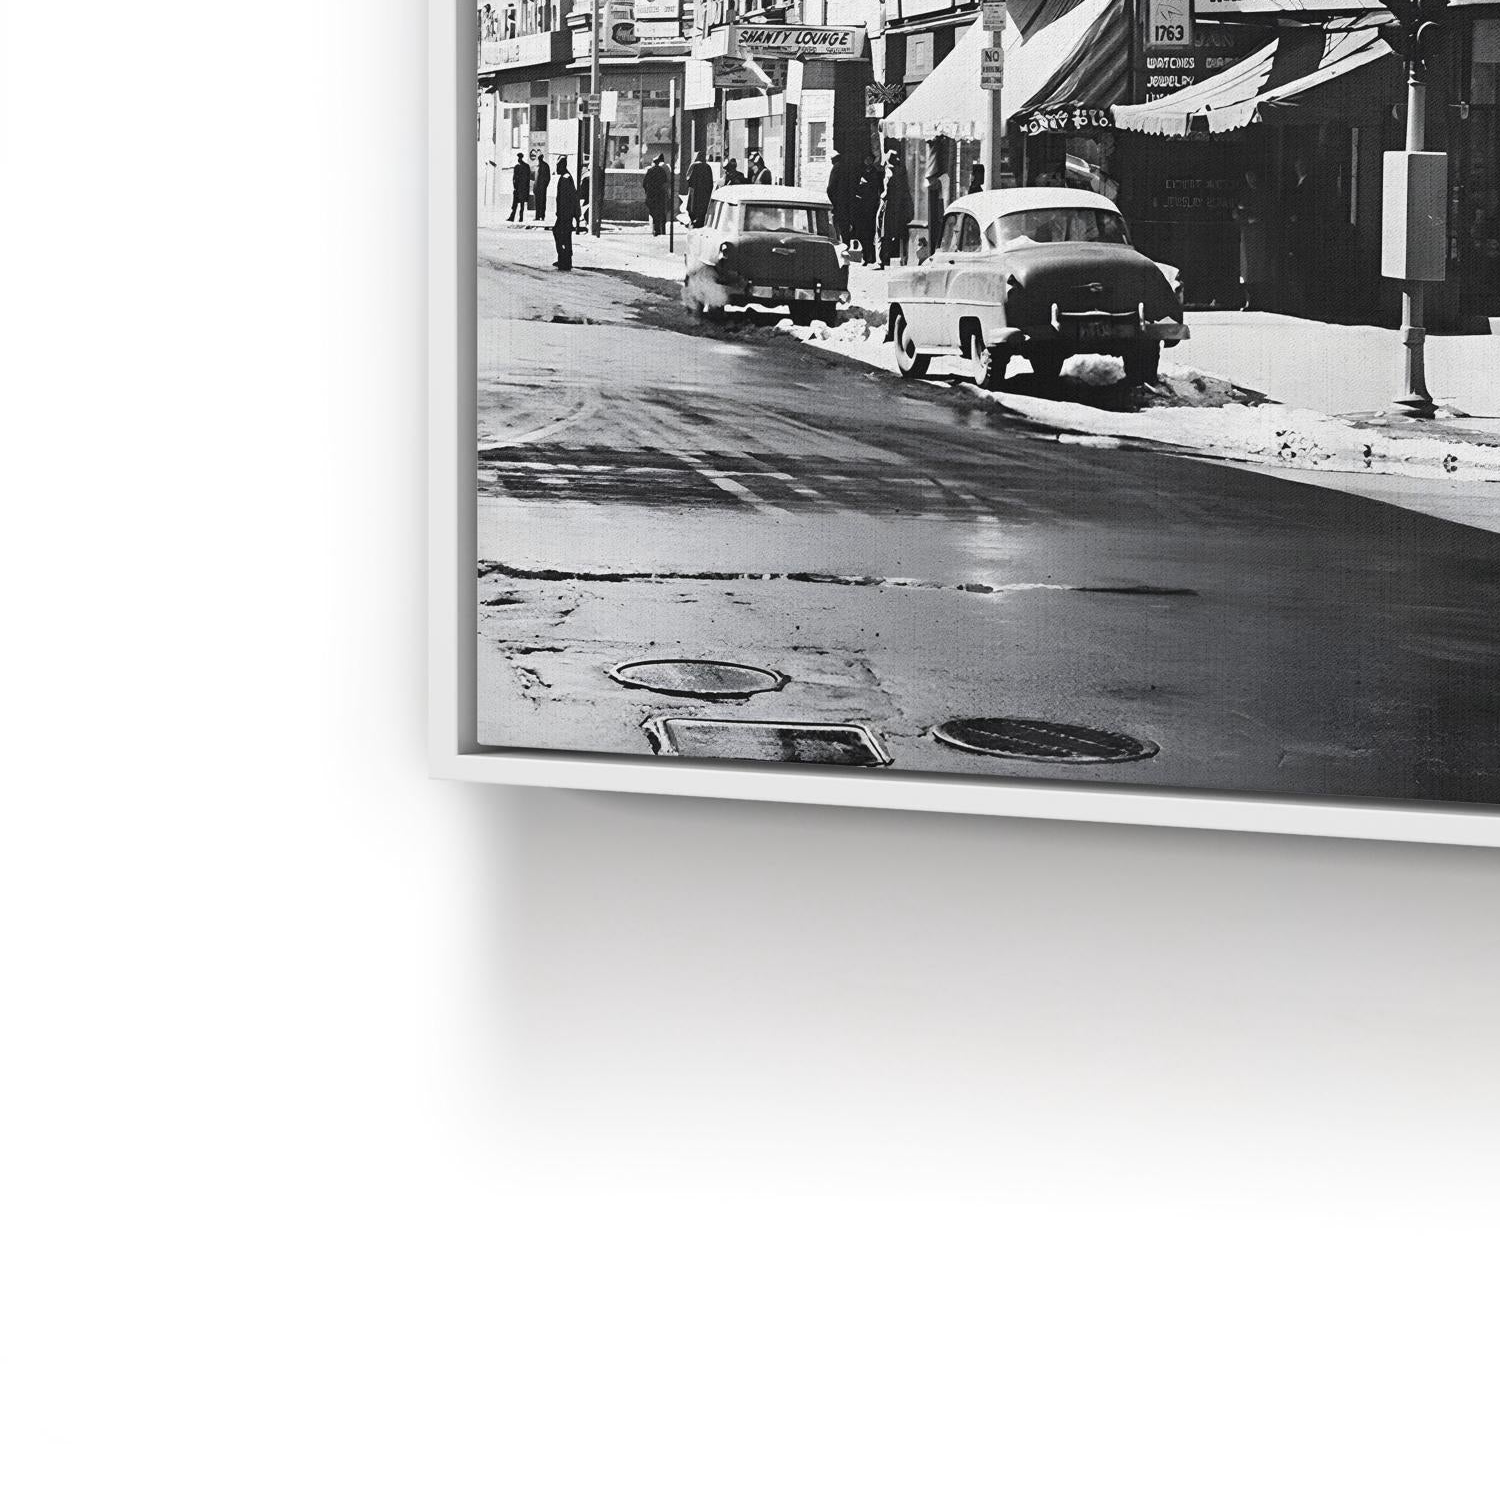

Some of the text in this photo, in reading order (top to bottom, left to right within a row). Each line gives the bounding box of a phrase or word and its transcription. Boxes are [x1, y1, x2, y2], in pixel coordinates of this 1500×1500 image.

[738, 30, 850, 46] SHANTY LOUNGE
[1155, 24, 1185, 42] 1763
[984, 50, 1000, 62] NO
